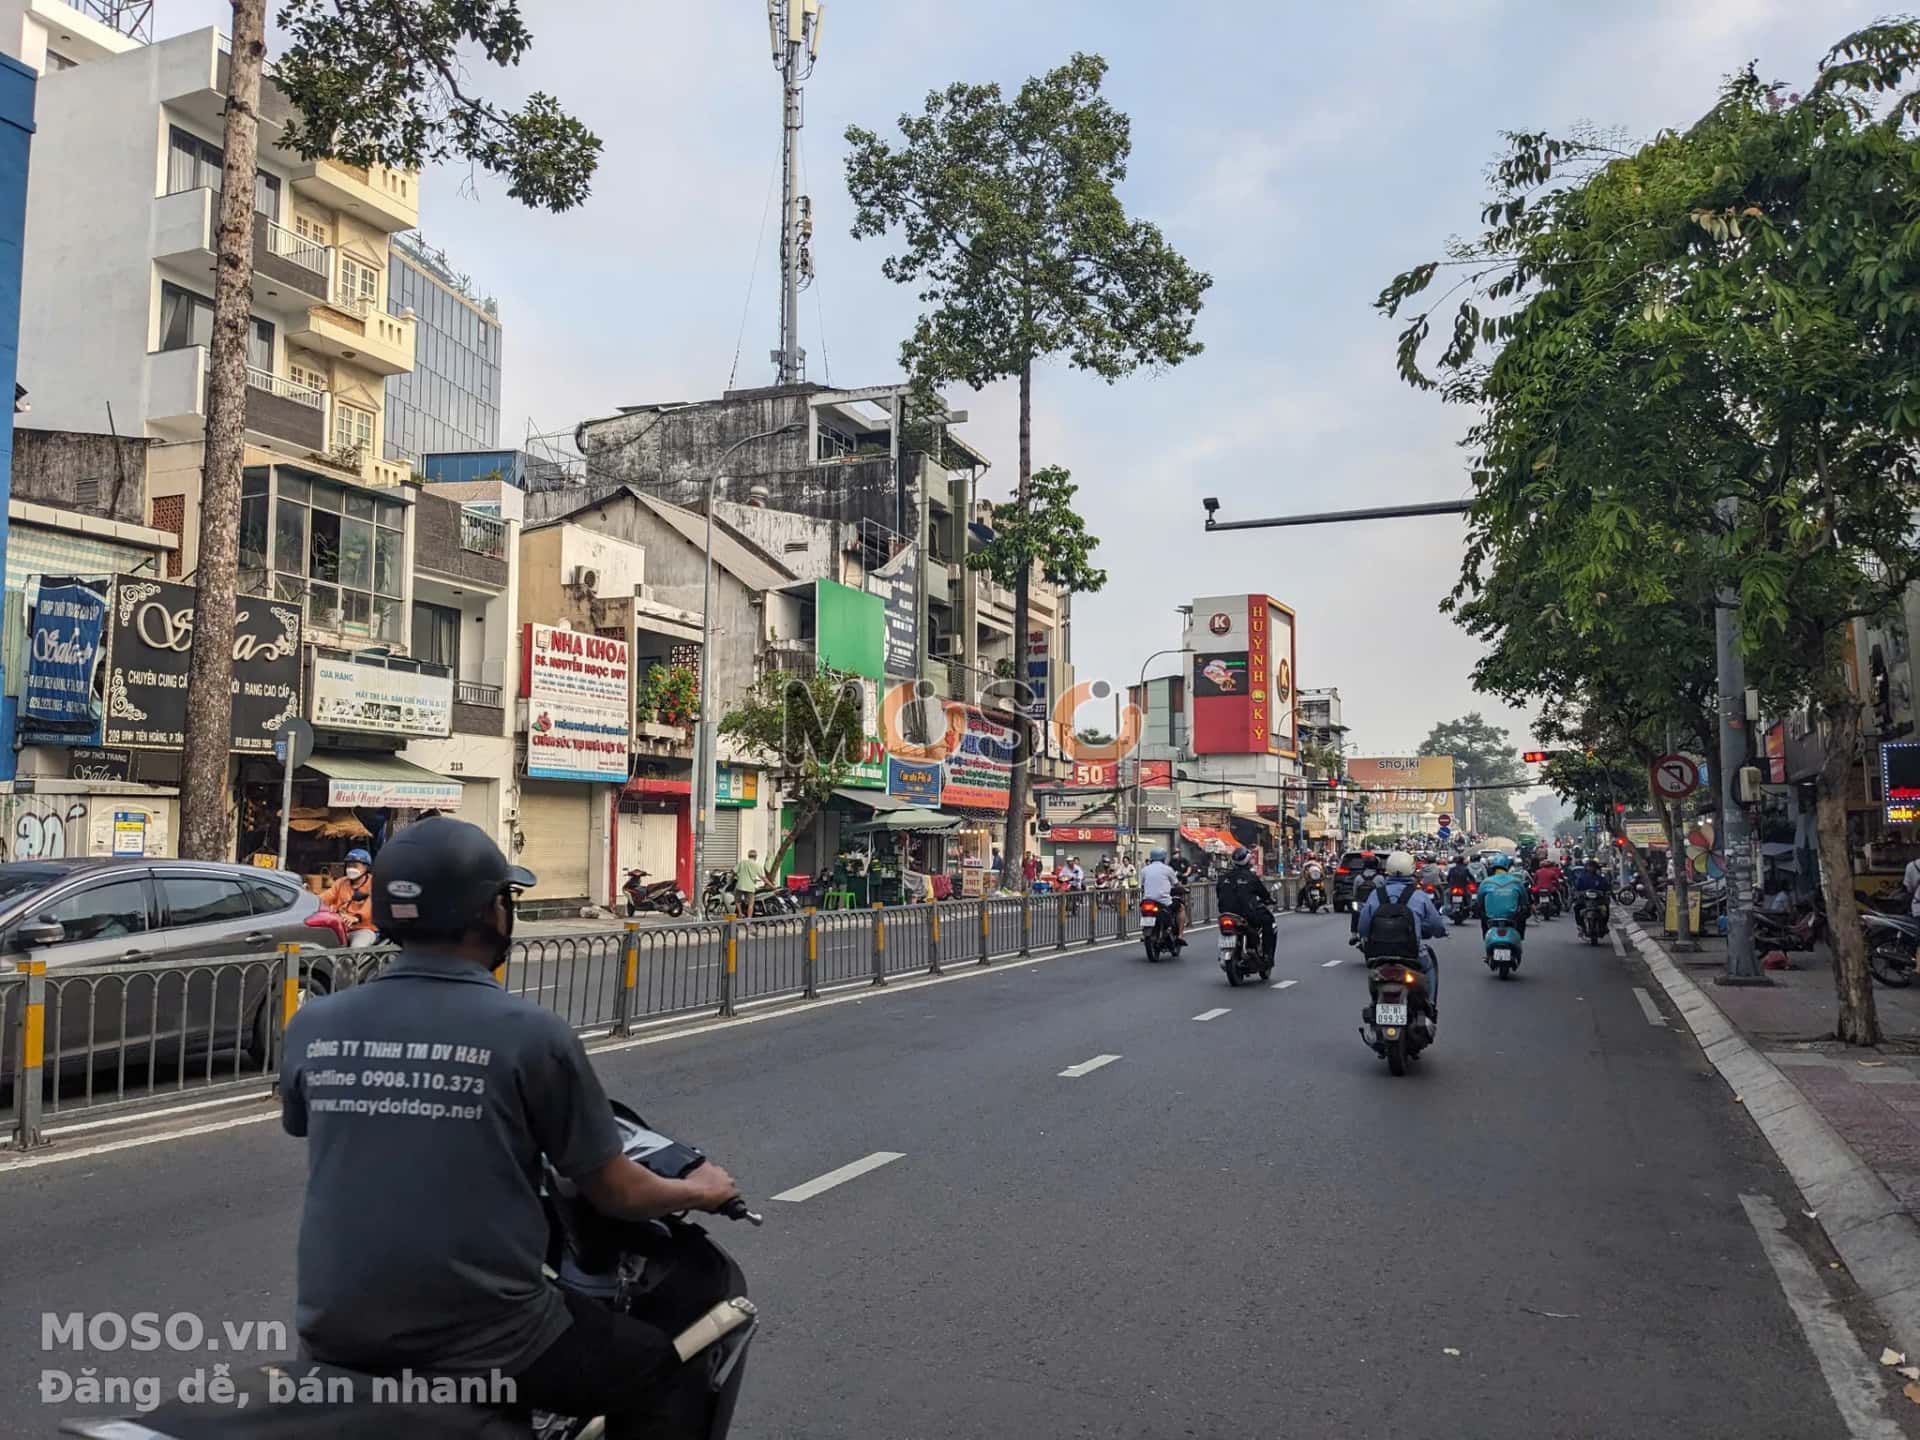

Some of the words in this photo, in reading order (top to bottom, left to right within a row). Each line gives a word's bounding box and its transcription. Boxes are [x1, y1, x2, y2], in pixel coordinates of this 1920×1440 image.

[551, 631, 583, 656] NHA
[586, 638, 627, 664] KHOA
[584, 664, 609, 678] NGỌC
[611, 667, 626, 680] DUY
[128, 669, 157, 686] CHUYÊN
[158, 673, 177, 687] CUNG
[264, 684, 276, 697] CAO
[277, 682, 290, 698] CẤP
[108, 730, 121, 743] 209
[74, 750, 90, 759] SHOP
[107, 753, 128, 762] TRANG
[1077, 766, 1103, 785] 50
[1078, 829, 1092, 840] 50
[341, 1040, 360, 1057] TY
[362, 1041, 404, 1059] TNHH
[406, 1043, 429, 1060] TM
[431, 1044, 453, 1061] DV
[454, 1046, 491, 1066] H&H
[361, 1070, 485, 1095] 0908.110.373
